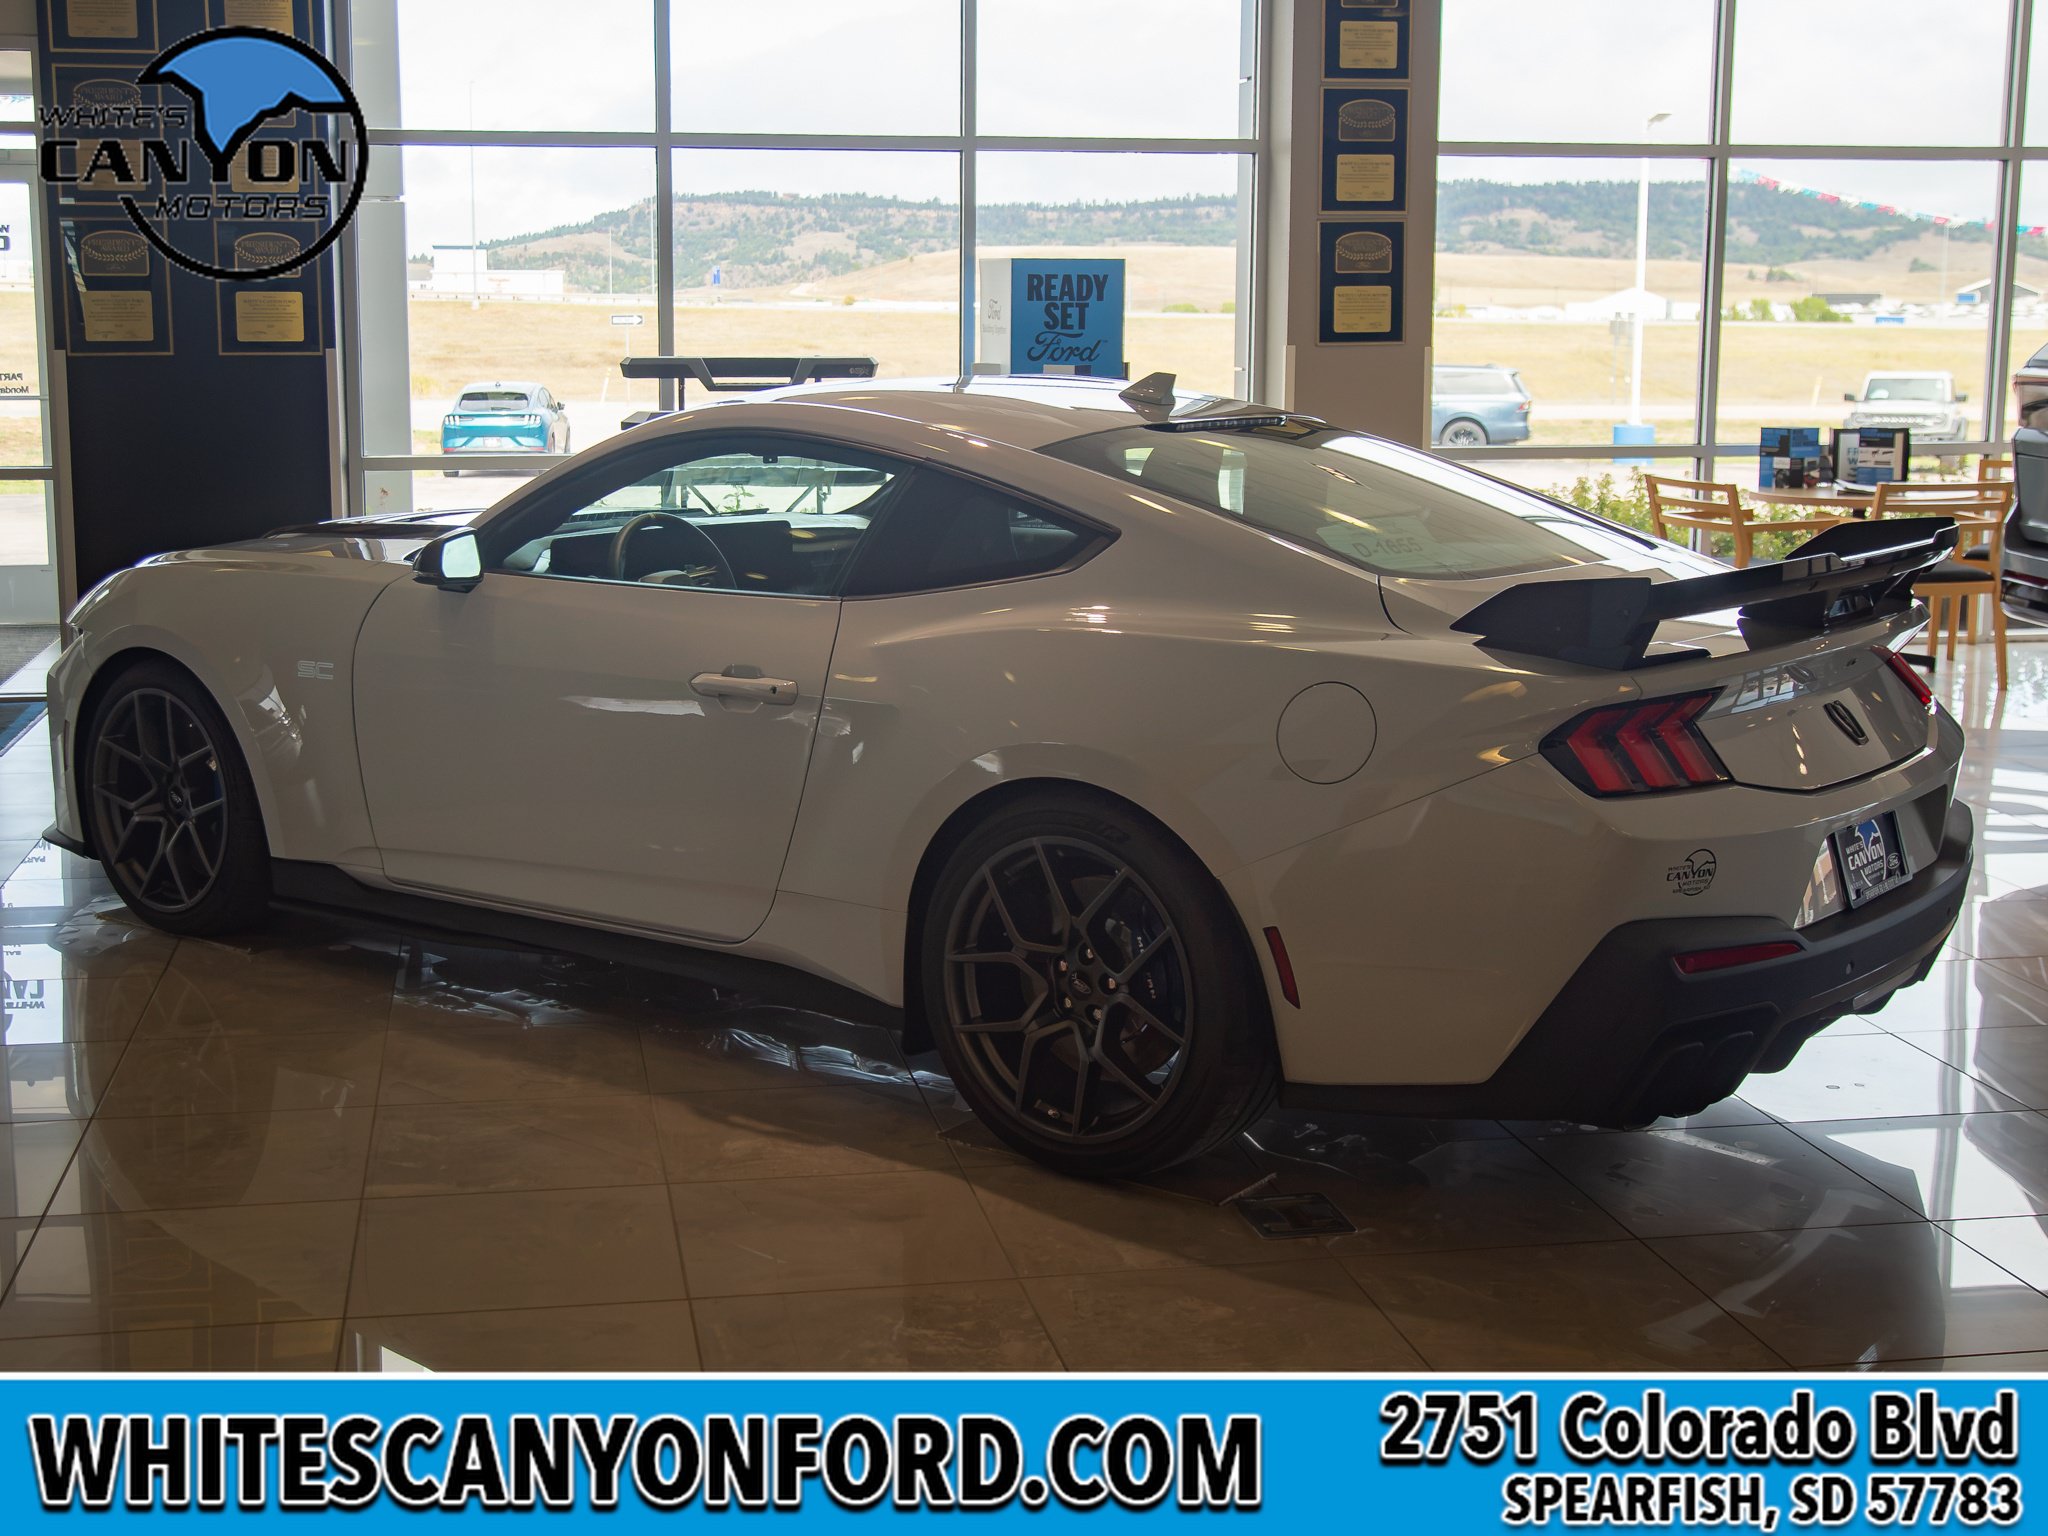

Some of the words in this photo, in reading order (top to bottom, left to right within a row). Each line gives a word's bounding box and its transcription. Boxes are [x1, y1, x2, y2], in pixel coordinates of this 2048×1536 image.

[1027, 273, 1109, 302] READY
[1044, 303, 1089, 330] SET
[1027, 331, 1103, 362] Ford
[1848, 842, 1885, 870] CANYON
[1667, 868, 1714, 882] CANYON
